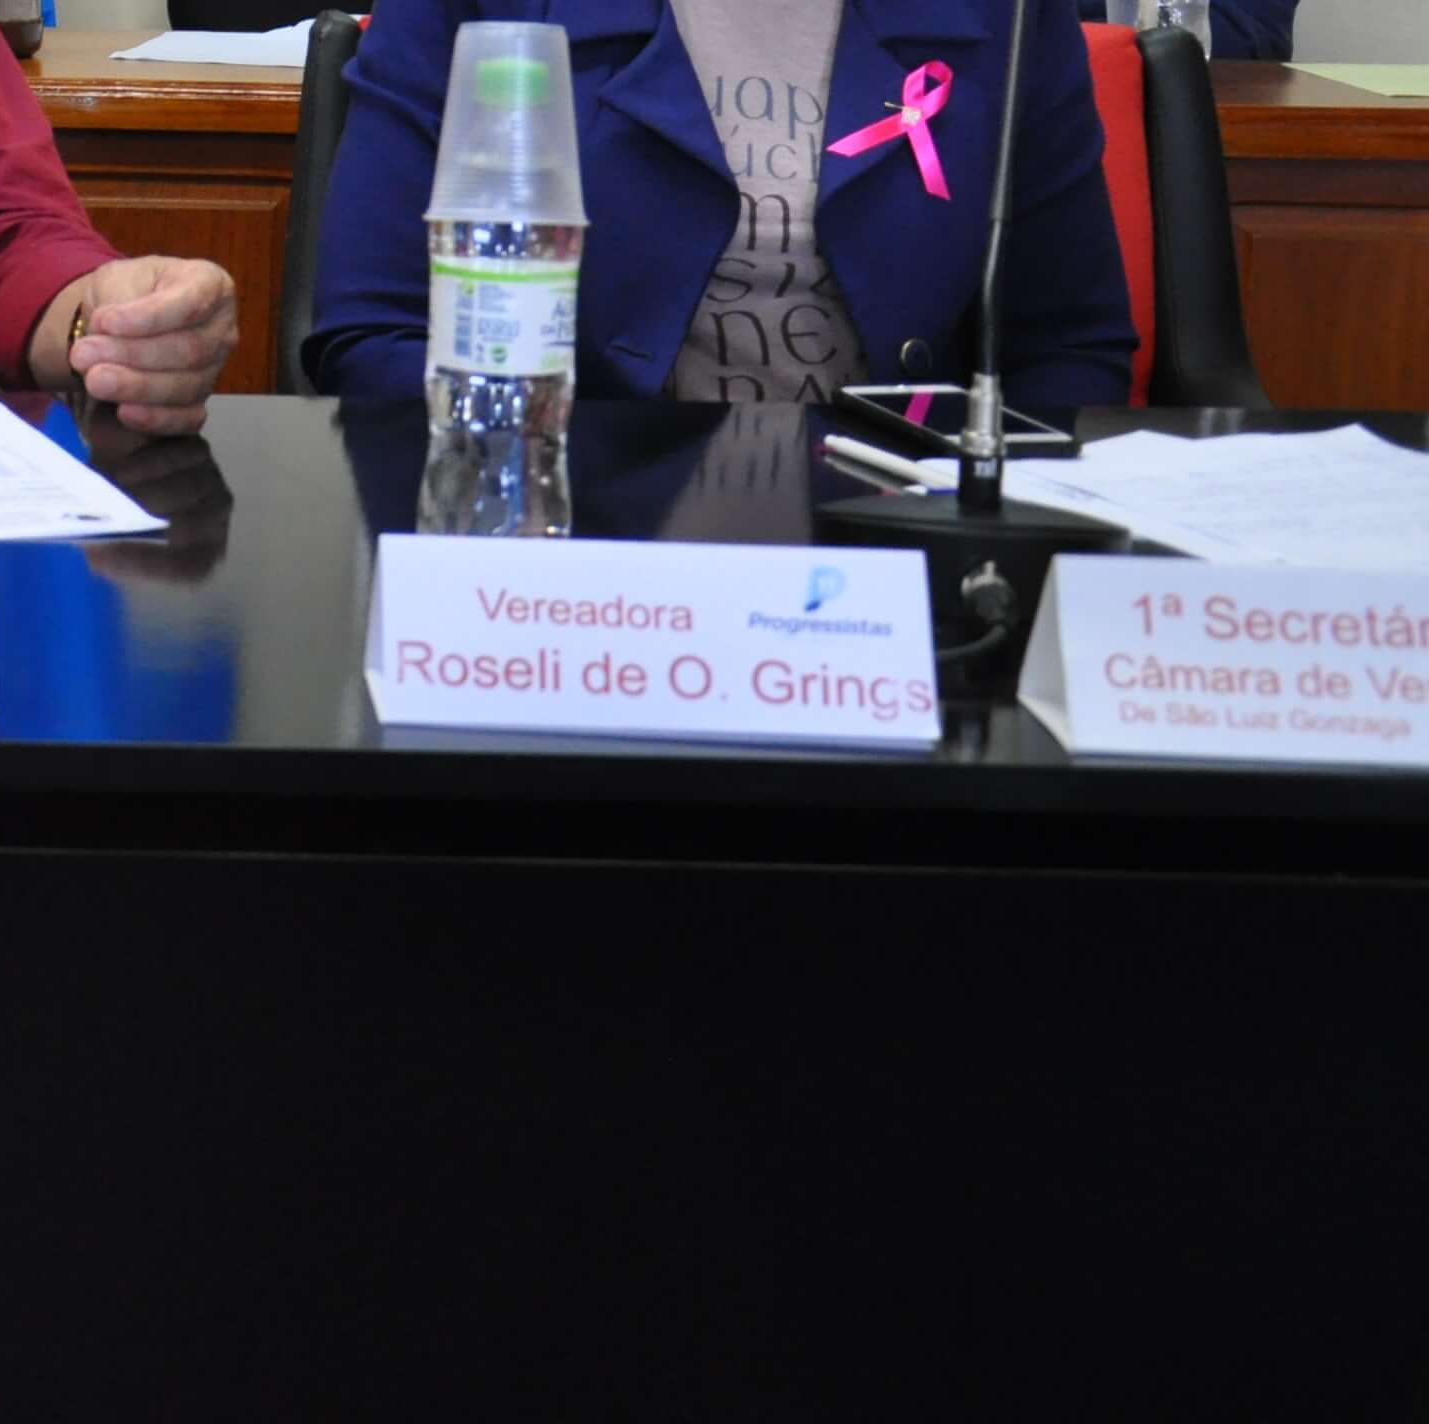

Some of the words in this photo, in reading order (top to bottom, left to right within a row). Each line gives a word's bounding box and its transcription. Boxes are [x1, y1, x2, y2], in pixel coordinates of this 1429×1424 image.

[478, 586, 694, 632] Vereadora
[747, 612, 893, 638] Progressistas
[396, 639, 561, 692] Roseli
[582, 653, 648, 696] de
[668, 656, 730, 702] O.
[1104, 652, 1282, 697] Câmara
[1296, 663, 1352, 700] de
[1119, 700, 1157, 724] De
[1165, 700, 1218, 728] São
[1225, 705, 1281, 731] Luiz
[1289, 708, 1412, 742] Gonzaga
